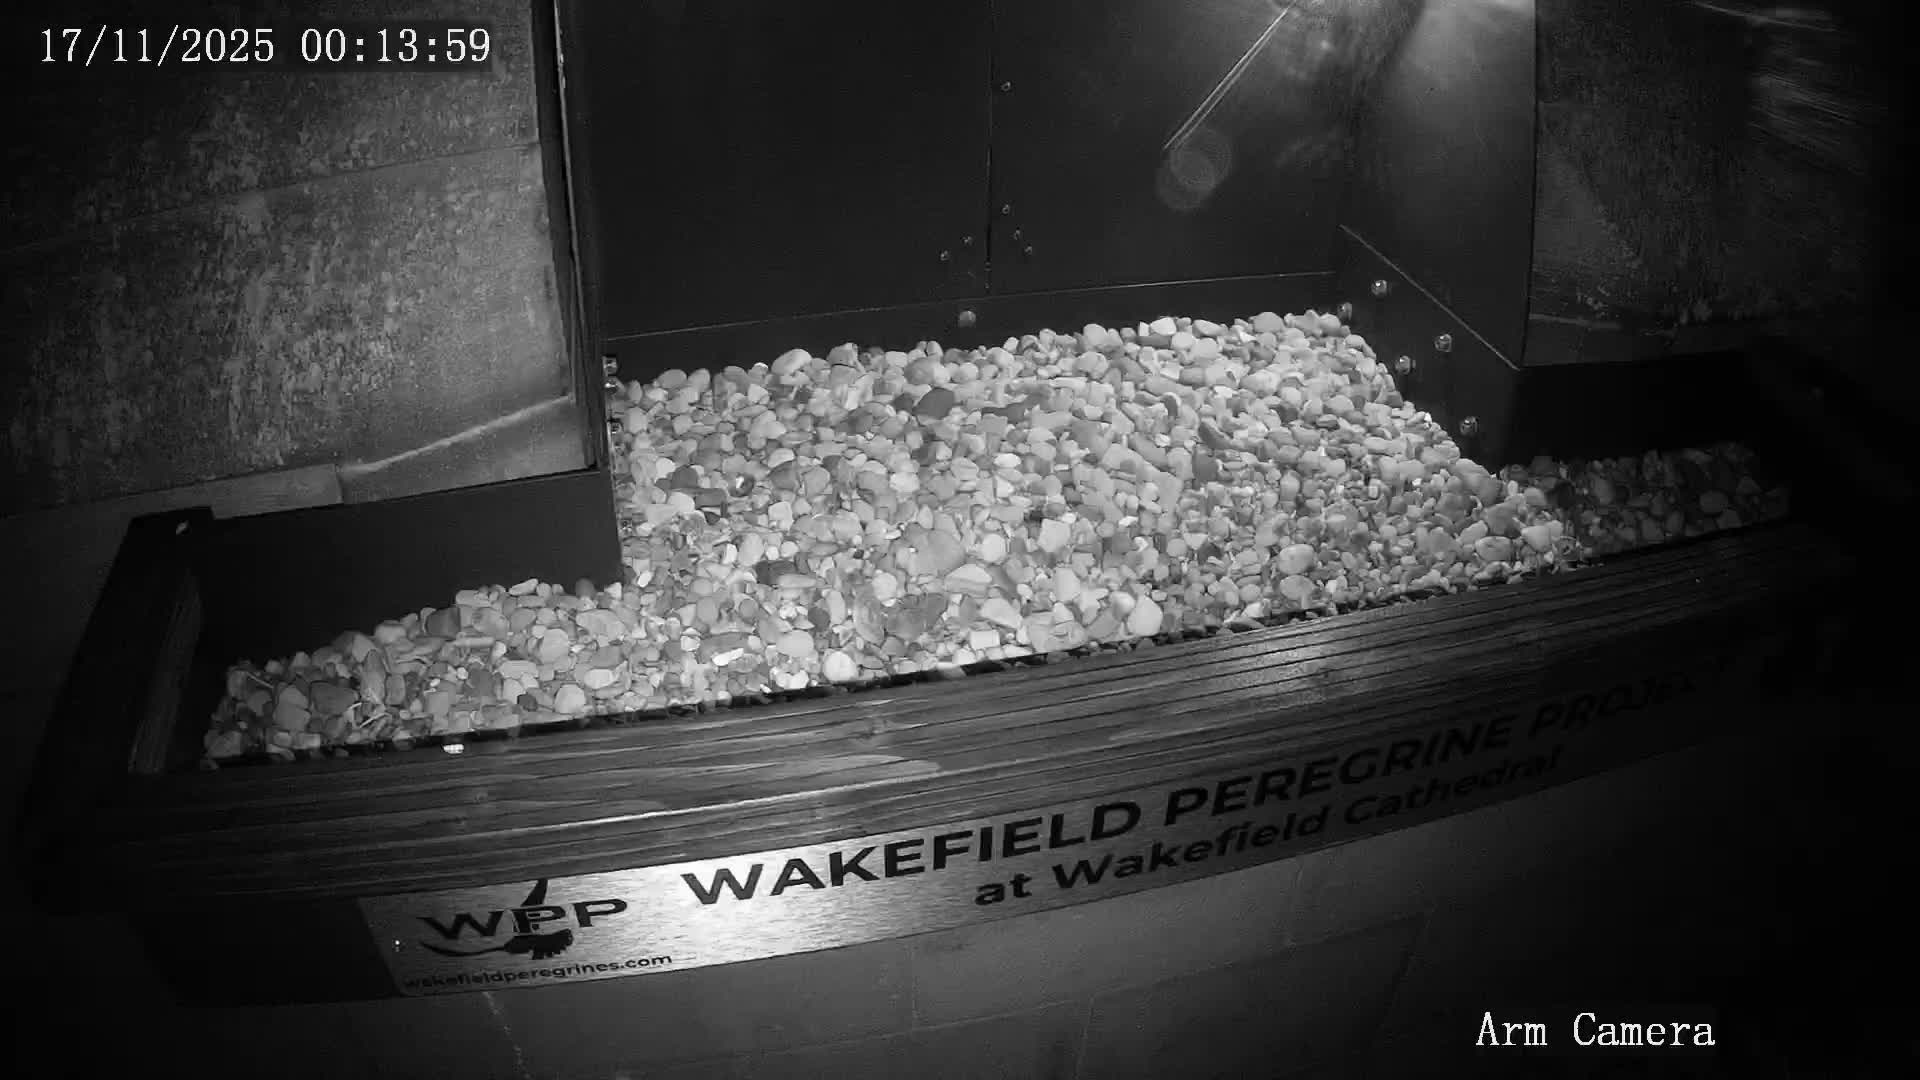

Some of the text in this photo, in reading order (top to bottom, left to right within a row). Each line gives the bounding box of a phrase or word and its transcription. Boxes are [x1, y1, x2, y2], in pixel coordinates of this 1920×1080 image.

[681, 802, 1141, 905] WAKEFIELD
[1164, 713, 1516, 825] PEREGRINE
[975, 745, 1563, 906] at Wakefield Cathedral
